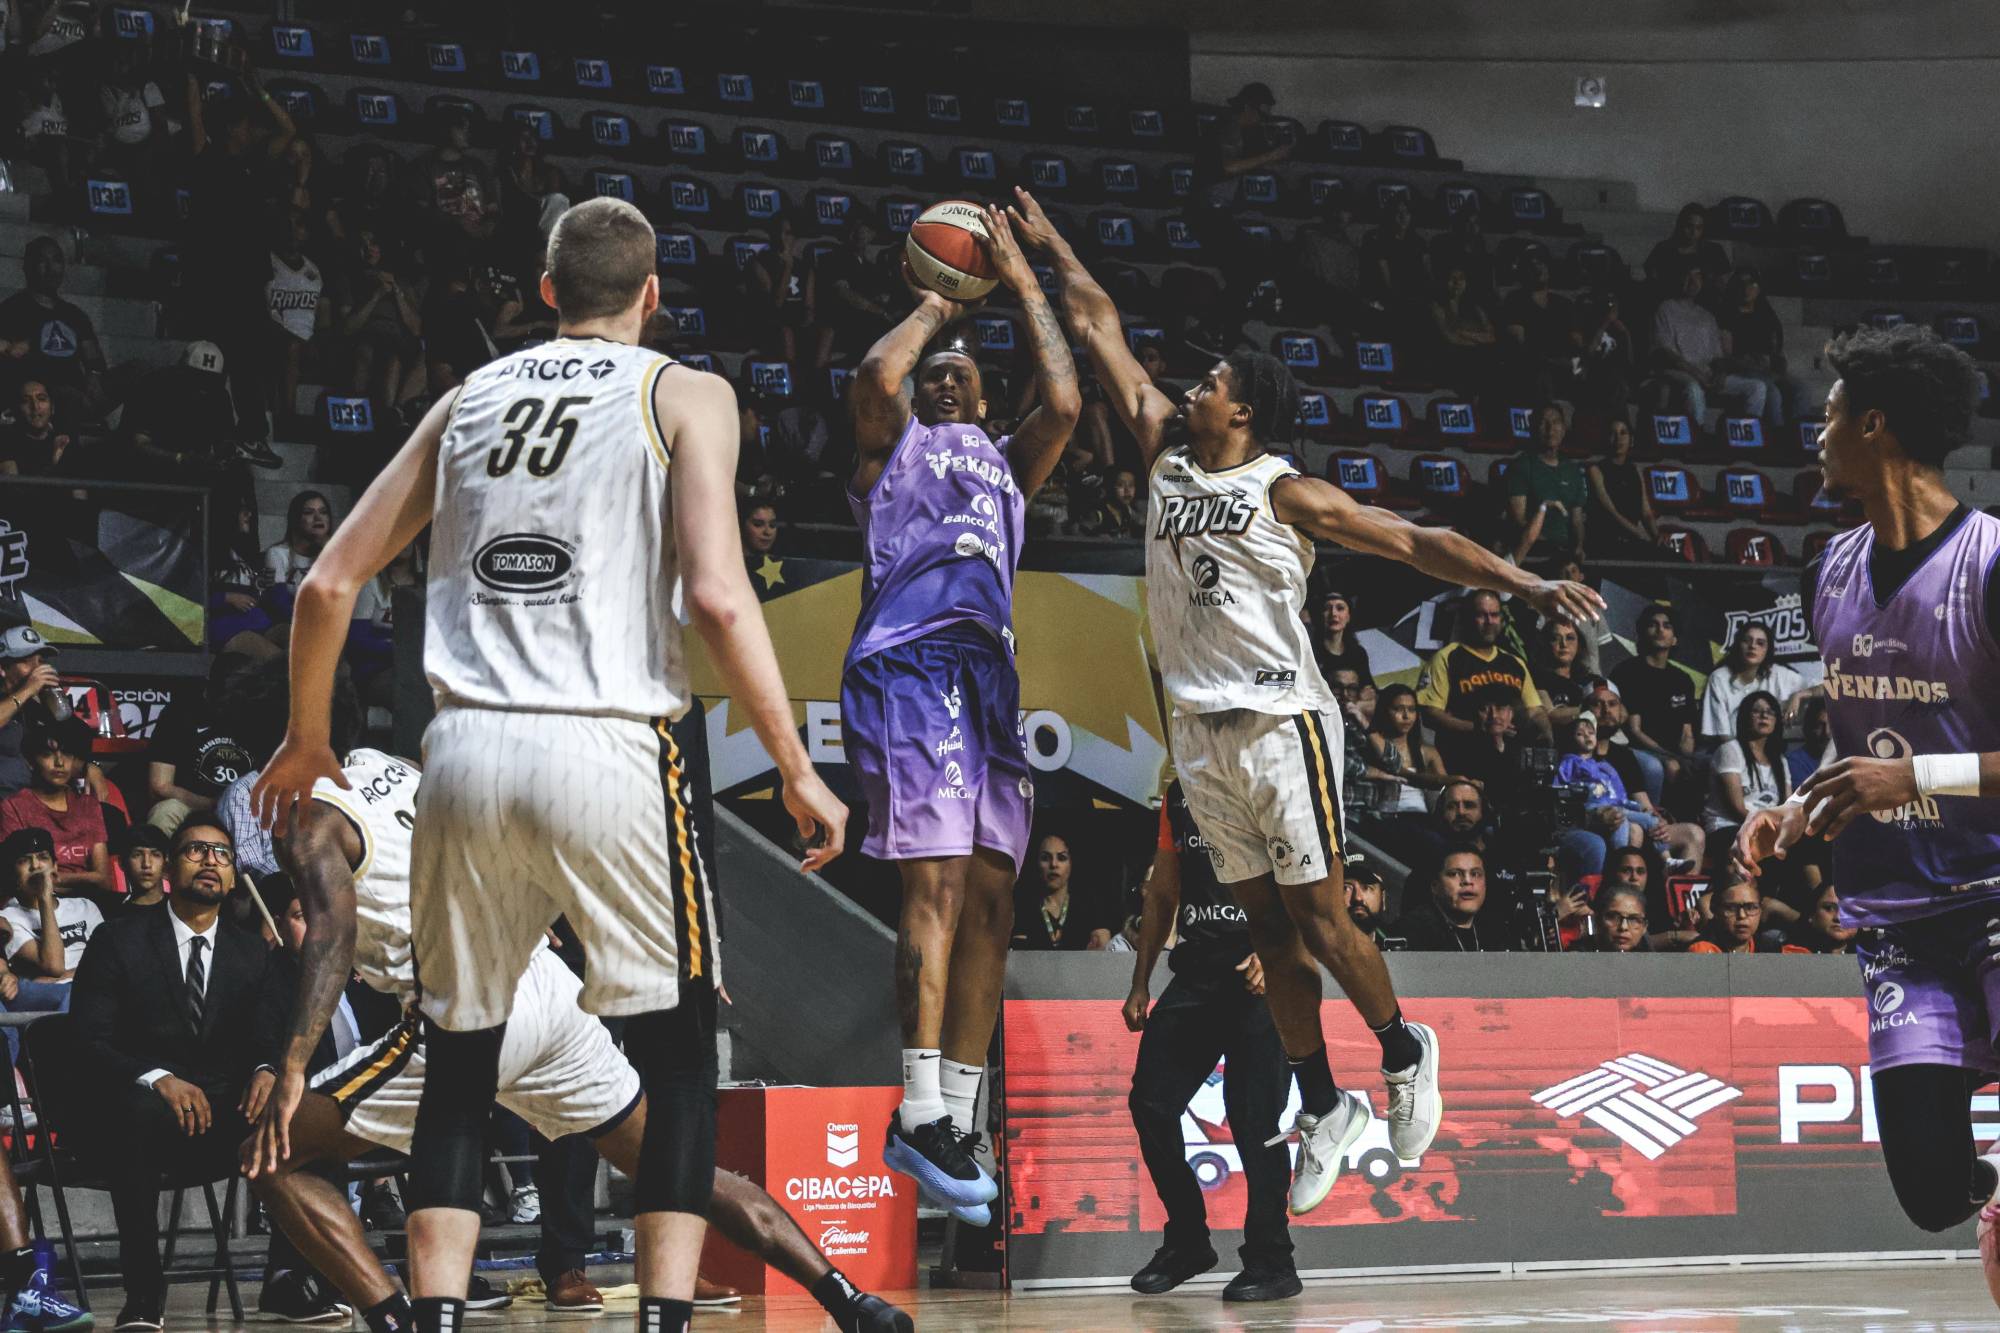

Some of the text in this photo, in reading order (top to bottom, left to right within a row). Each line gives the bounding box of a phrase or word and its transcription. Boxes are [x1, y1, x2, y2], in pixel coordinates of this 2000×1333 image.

[117, 13, 145, 32] 019
[91, 187, 127, 208] 032
[936, 272, 959, 287] FIBA
[270, 290, 319, 310] RAYOS
[203, 354, 216, 368] H
[1367, 404, 1393, 423] 021
[1440, 409, 1470, 427] 020
[486, 396, 593, 478] 35
[1657, 421, 1681, 439] 017
[926, 449, 1016, 496] VENADO
[1342, 464, 1369, 483] 021
[1654, 477, 1677, 495] 017
[1730, 480, 1754, 498] 016
[943, 514, 984, 528] Banco
[1156, 495, 1258, 541] RAYOS
[492, 554, 556, 572] TOMASON
[1189, 590, 1235, 607] MEGA
[1823, 658, 1948, 703] VENADOS
[214, 766, 238, 783] 30
[1197, 904, 1247, 921] MEGA
[1871, 1011, 1917, 1033] MEGA
[827, 1122, 858, 1131] Chevron
[785, 1176, 894, 1200] CIBACOPA
[820, 1226, 869, 1247] Caliente
